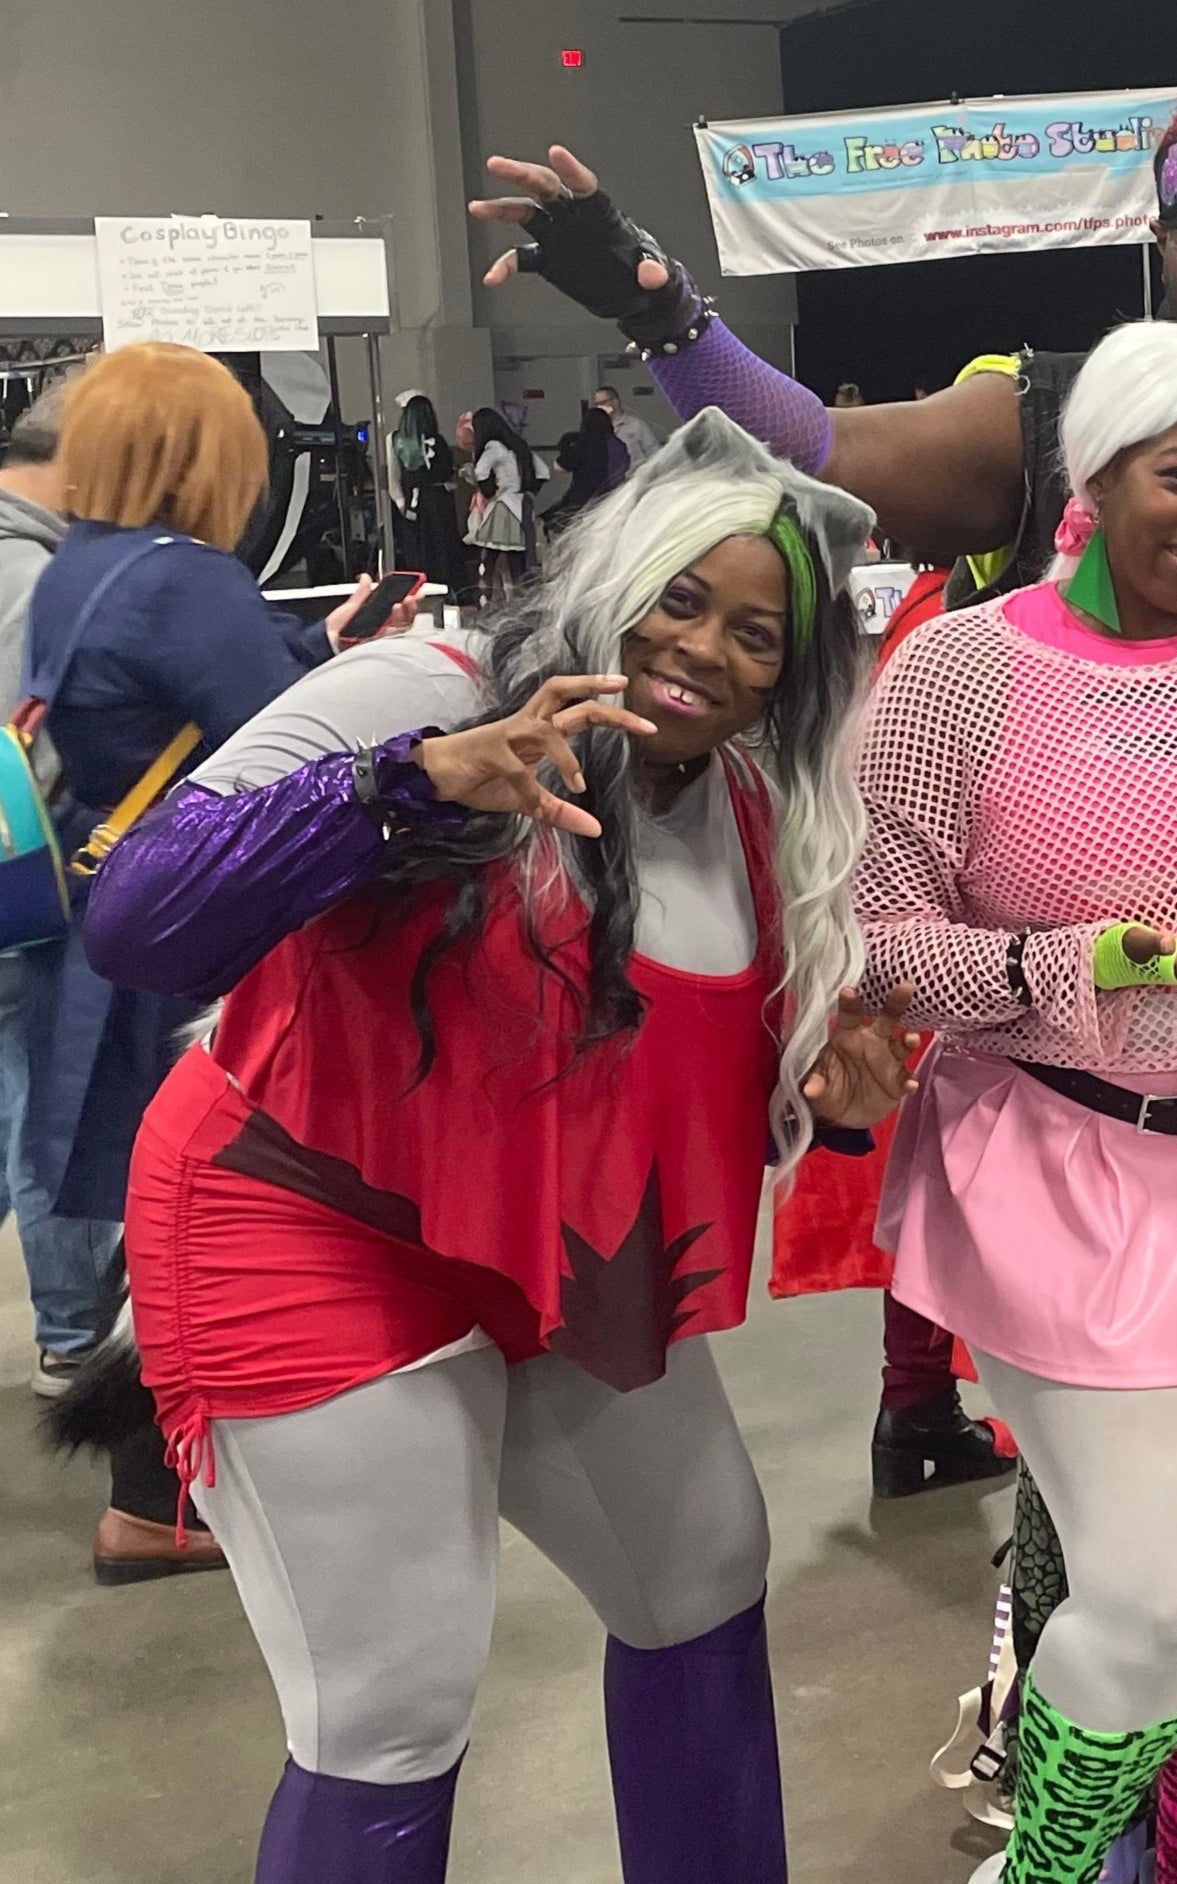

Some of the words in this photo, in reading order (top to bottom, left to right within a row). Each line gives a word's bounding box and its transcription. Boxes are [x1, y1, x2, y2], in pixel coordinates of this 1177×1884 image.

[752, 142, 835, 180] The
[844, 136, 925, 174] Free
[931, 122, 1040, 164] Photo
[120, 222, 219, 250] Cosplay
[223, 221, 290, 251] Bingo
[849, 237, 889, 249] Photos
[890, 235, 904, 245] on
